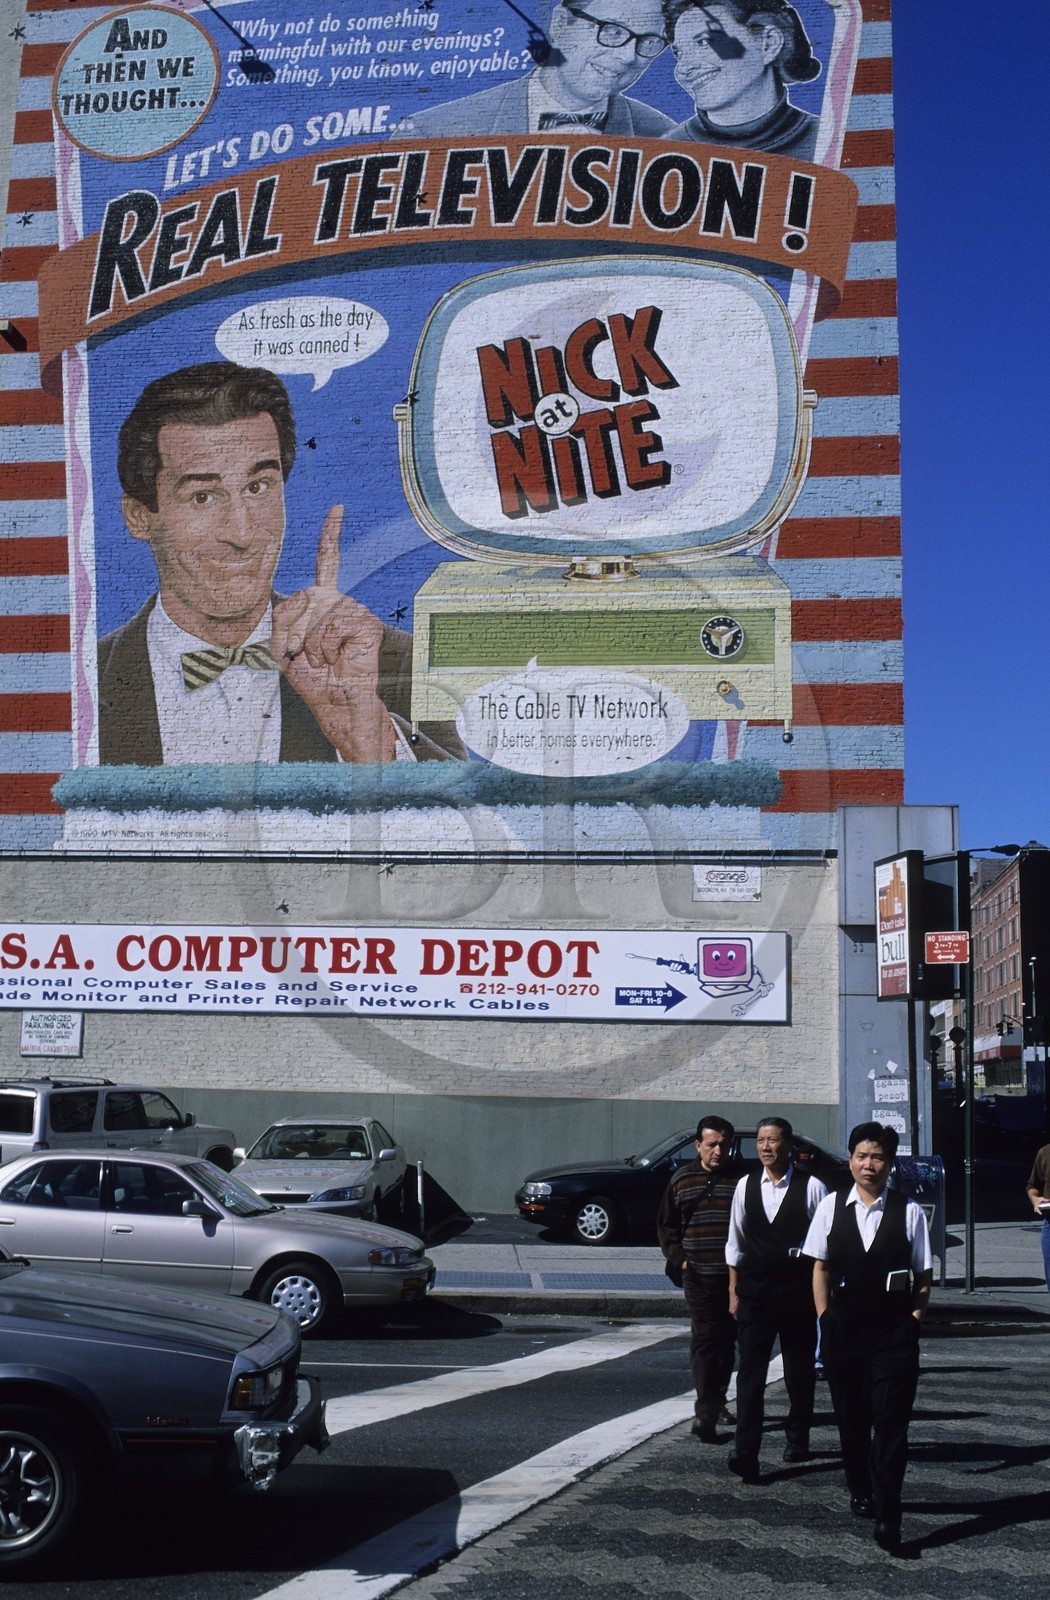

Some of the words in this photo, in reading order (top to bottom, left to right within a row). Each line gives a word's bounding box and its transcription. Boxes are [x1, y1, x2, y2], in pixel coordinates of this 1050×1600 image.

[103, 17, 168, 55] AND
[232, 17, 280, 42] "Why
[284, 18, 314, 35] not
[319, 13, 340, 33] do
[347, 8, 440, 32] something
[227, 37, 327, 65] meaningful
[331, 34, 371, 57] with
[376, 38, 407, 54] our
[412, 27, 505, 53] evenings?
[82, 60, 147, 86] THEN
[157, 56, 195, 81] WE
[226, 63, 324, 88] Something,
[329, 65, 364, 88] you
[367, 58, 424, 79] know,
[61, 87, 206, 117] THOUGHT...
[164, 136, 241, 191] LET'S
[249, 126, 294, 162] DO
[305, 104, 415, 146] SOME...
[85, 173, 283, 326] REAL
[238, 312, 255, 331] As
[260, 307, 295, 330] fresh
[300, 313, 315, 328] as
[320, 305, 342, 327] the
[347, 304, 374, 331] day
[253, 338, 263, 356] it
[267, 341, 294, 356] was
[539, 398, 574, 429] at
[478, 692, 508, 721] The
[515, 692, 561, 721] Cable
[566, 693, 587, 721] TV
[594, 690, 669, 720] Network
[486, 729, 498, 748] In
[501, 728, 537, 749] better
[540, 728, 578, 748] homes
[581, 728, 657, 752] everywhere.
[101, 829, 118, 838] MTV
[121, 829, 155, 839] Networks
[159, 829, 169, 838] All
[171, 829, 193, 839] rights
[881, 932, 906, 963] bull
[938, 934, 967, 942] STANDING
[0, 932, 95, 971] S.A.
[116, 933, 398, 974] COMPUTER
[419, 938, 601, 979] DEPOT
[42, 990, 128, 1003] Monitor
[138, 993, 177, 1004] and
[188, 993, 265, 1006] Printer
[275, 995, 349, 1008] Repair
[360, 996, 457, 1009] Network
[469, 998, 551, 1011] Cables
[83, 977, 194, 992] Computer
[204, 979, 267, 992] Sales
[277, 981, 318, 993] and
[329, 980, 419, 994] Service
[477, 982, 601, 996] 212-941-0270
[619, 989, 653, 997] MON-FRI
[655, 989, 673, 997] 10-6
[25, 1021, 55, 1029] PARKING
[56, 1021, 77, 1029] ONLY
[30, 1014, 72, 1022] AUTHORIZED
